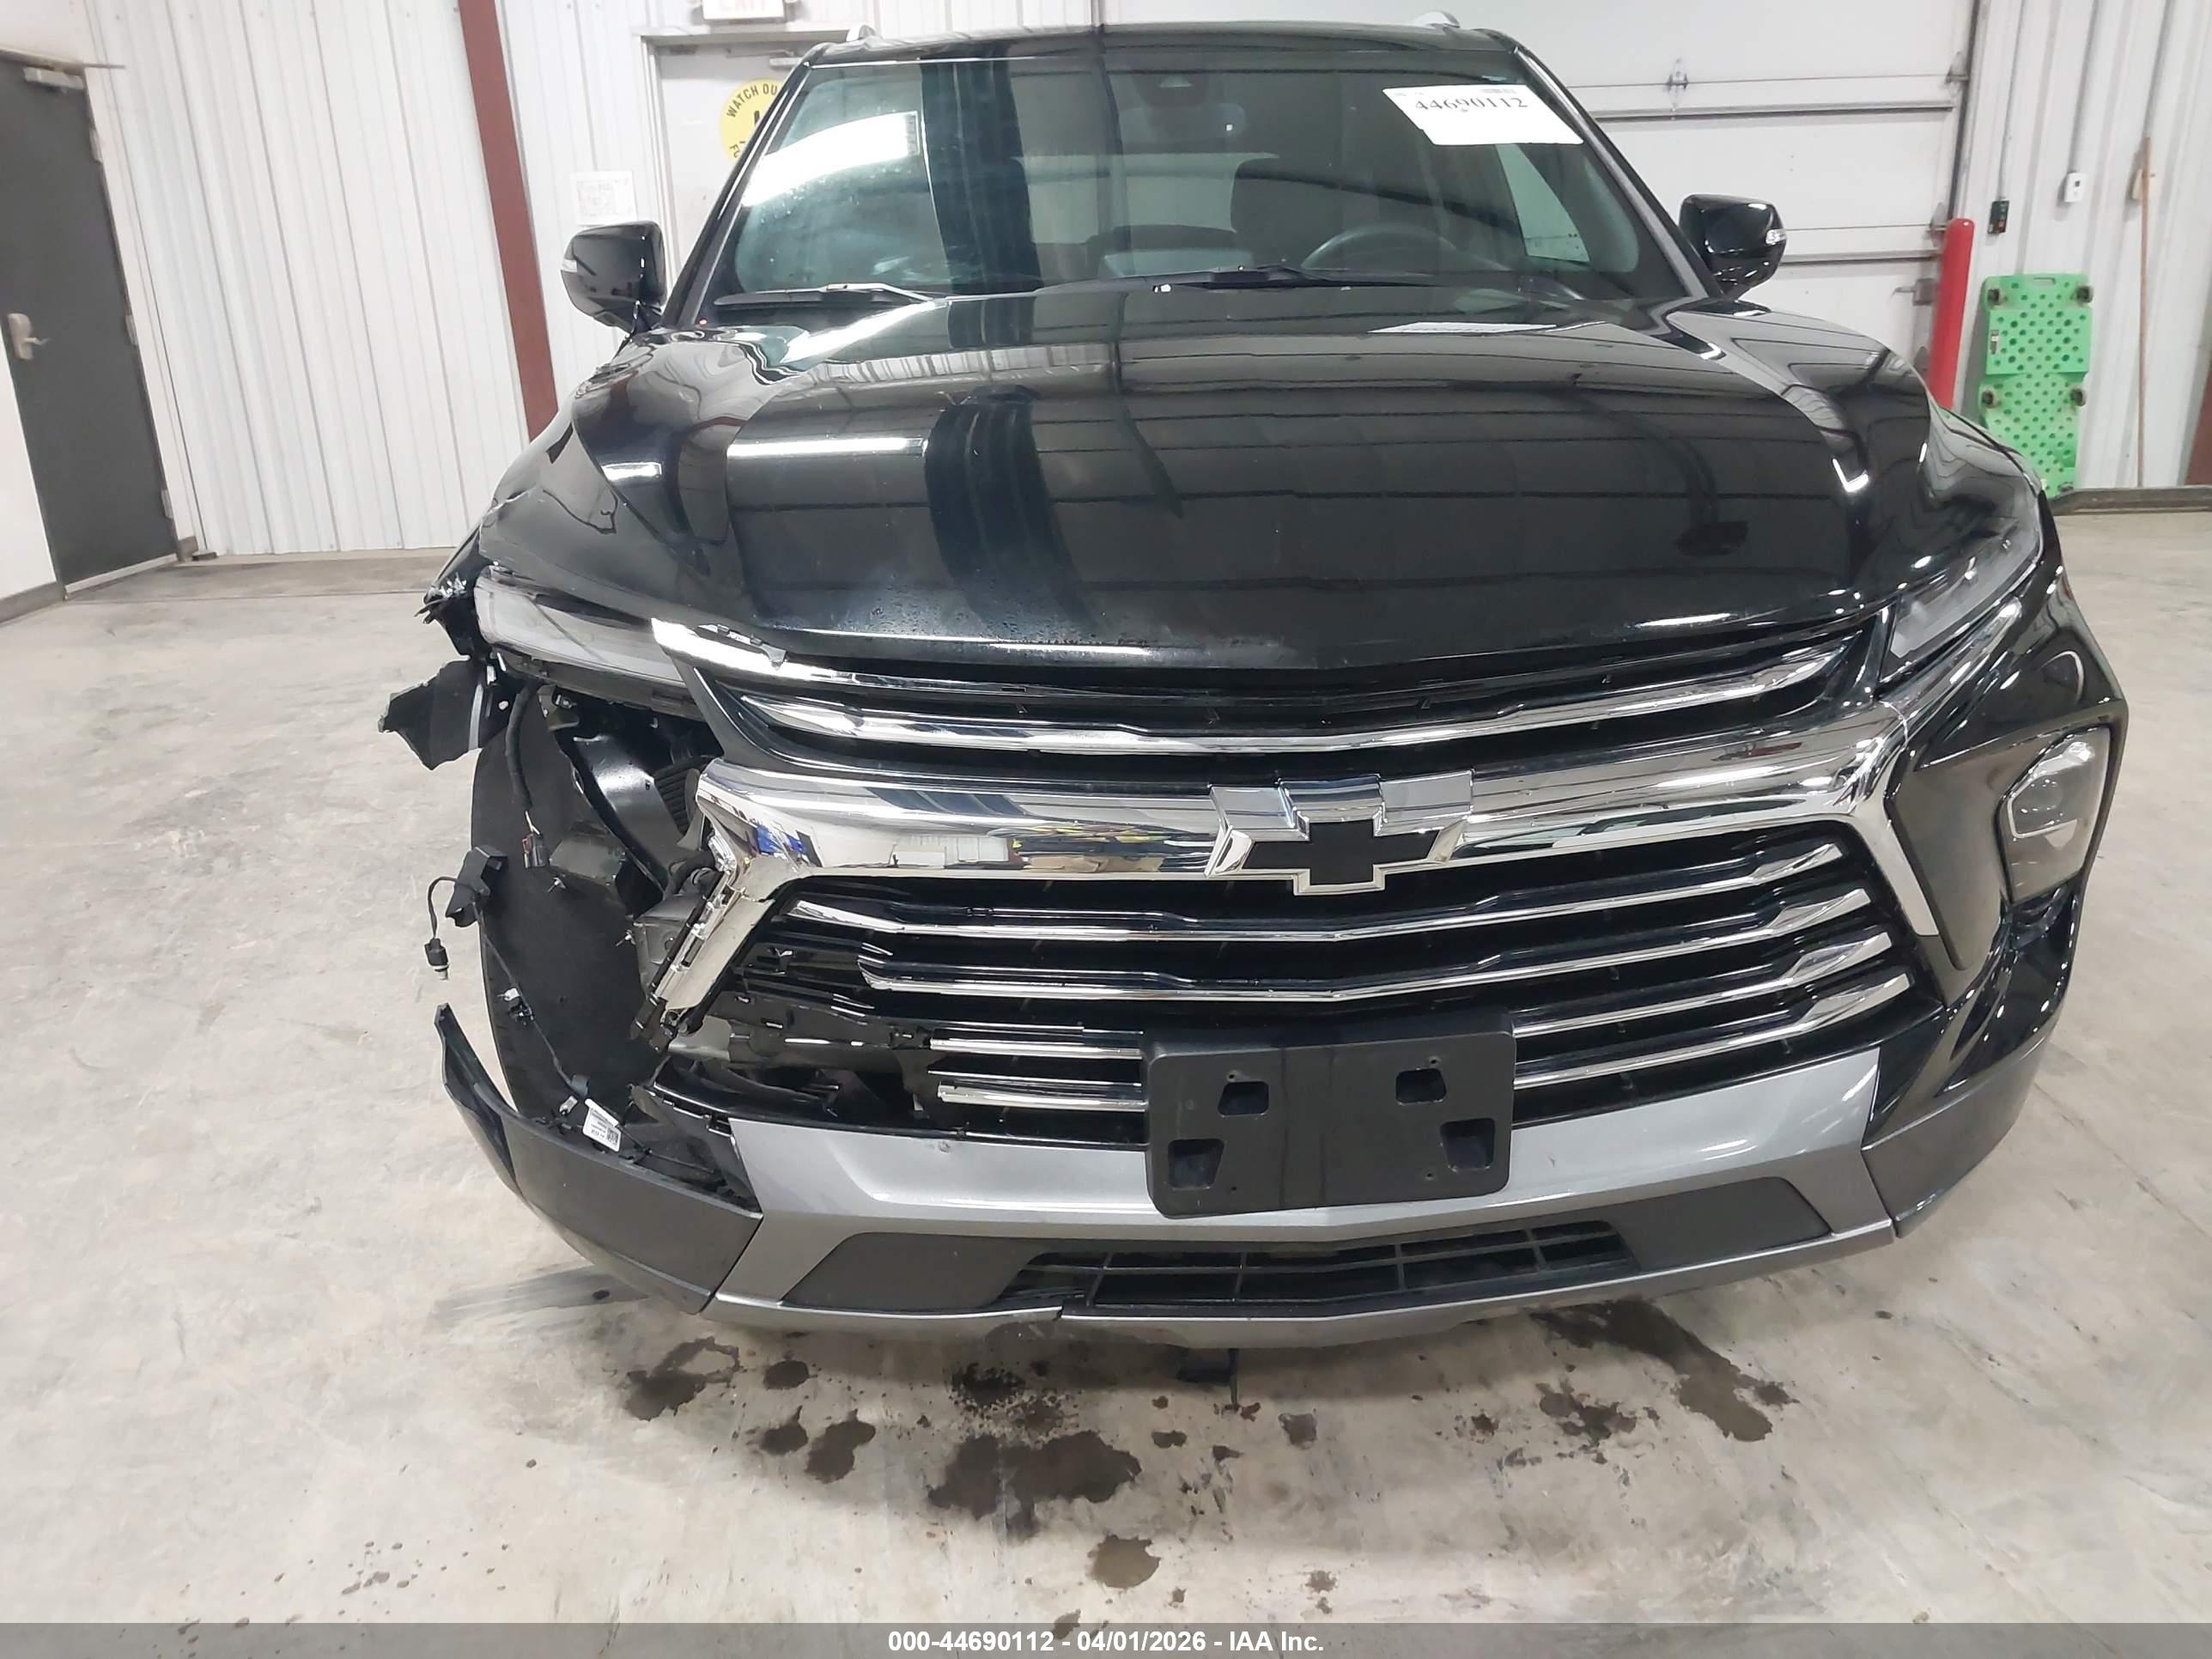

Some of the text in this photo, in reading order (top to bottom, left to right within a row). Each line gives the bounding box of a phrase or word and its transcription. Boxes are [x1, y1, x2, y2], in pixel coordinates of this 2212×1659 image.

[726, 83, 778, 118] WATCH OU
[1415, 97, 1528, 112] 44690112
